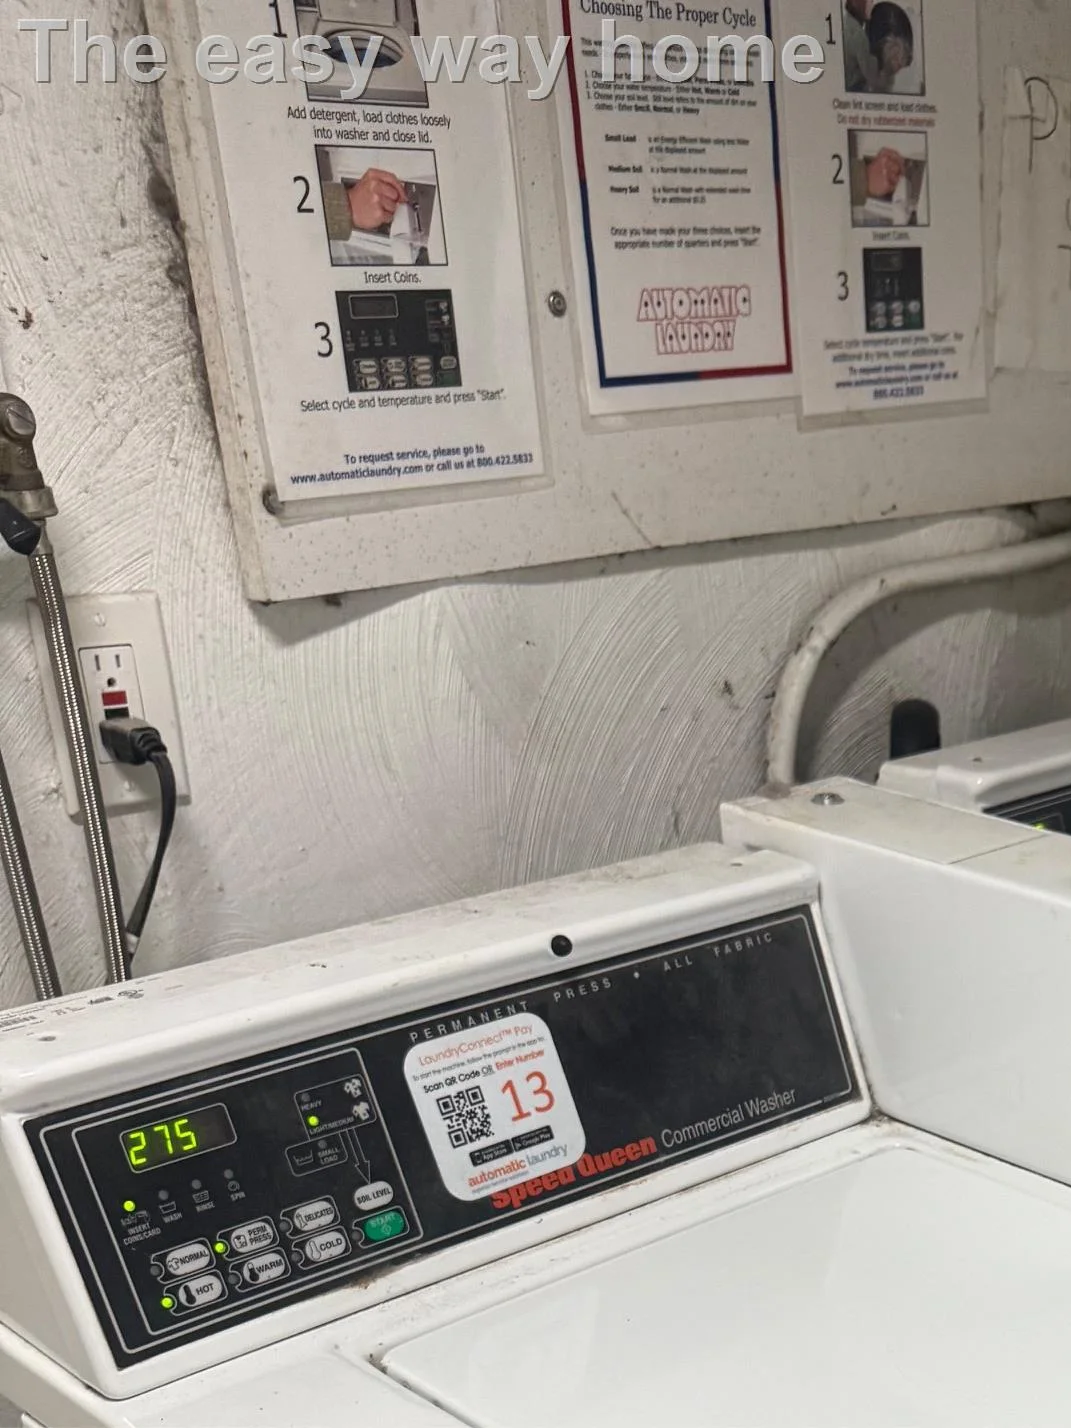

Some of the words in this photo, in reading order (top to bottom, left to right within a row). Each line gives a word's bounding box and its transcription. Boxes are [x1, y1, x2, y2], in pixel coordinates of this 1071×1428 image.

[269, 0, 287, 38] 1
[580, 0, 643, 21] Choosing
[646, 1, 672, 20] The
[677, 4, 718, 26] Proper
[723, 7, 757, 29] Cycle
[825, 13, 836, 45] 1
[287, 106, 306, 120] Add
[310, 108, 360, 124] detergent,
[362, 110, 383, 123] load
[385, 111, 418, 125] clothes
[420, 113, 451, 129] loosely
[314, 126, 333, 139] into
[335, 128, 369, 141] washer
[372, 129, 390, 142] and
[393, 130, 416, 143] close
[418, 131, 432, 143] lid.
[831, 155, 845, 186] 2
[293, 175, 315, 215] 2
[363, 269, 393, 286] Insert
[395, 267, 422, 285] Coins.
[837, 270, 849, 301] 3
[636, 284, 752, 322] AUTOMATIC
[314, 321, 334, 357] 3
[655, 319, 736, 355] LAUNDRY
[301, 399, 330, 412] Select
[332, 398, 356, 411] cycle
[358, 396, 376, 409] and
[378, 394, 432, 409] temperature
[435, 392, 451, 404] and
[453, 392, 476, 406] press
[344, 454, 356, 465] To
[359, 451, 394, 465] request
[396, 448, 431, 461] service,
[432, 445, 460, 459] please
[462, 445, 474, 457] go
[475, 444, 485, 454] to
[290, 464, 423, 485] www.automaticlaundry.com
[425, 463, 434, 472] or
[436, 460, 451, 472] call
[454, 460, 464, 470] us
[466, 458, 475, 469] at
[409, 1001, 530, 1044] PERMANENT
[553, 976, 613, 1003] PRESS
[663, 955, 694, 973] ALL
[714, 930, 773, 959] FABRIC
[514, 1023, 533, 1038] Pay
[423, 1081, 443, 1094] Scan
[445, 1075, 457, 1086] QR
[458, 1070, 481, 1083] Code
[482, 1064, 495, 1077] OR
[495, 1057, 515, 1071] Enter
[516, 1049, 545, 1065] Number
[500, 1070, 556, 1123] 13
[127, 1118, 197, 1167] 275
[576, 1136, 657, 1177] Queen
[660, 1101, 745, 1150] Commercial
[743, 1087, 797, 1120] Washer
[318, 1147, 340, 1157] SMALL
[320, 1154, 339, 1165] LOAD
[468, 1159, 527, 1187] automatic
[526, 1143, 568, 1166] laundry
[357, 1193, 372, 1204] SOIL
[373, 1186, 391, 1199] LEVEL
[162, 1212, 183, 1224] WASH
[247, 1225, 267, 1237] PERM
[249, 1232, 272, 1246] PRESS
[179, 1250, 209, 1265] NORMAL
[320, 1238, 343, 1252] COLD
[256, 1258, 284, 1274] WARM
[195, 1283, 215, 1295] HOT
